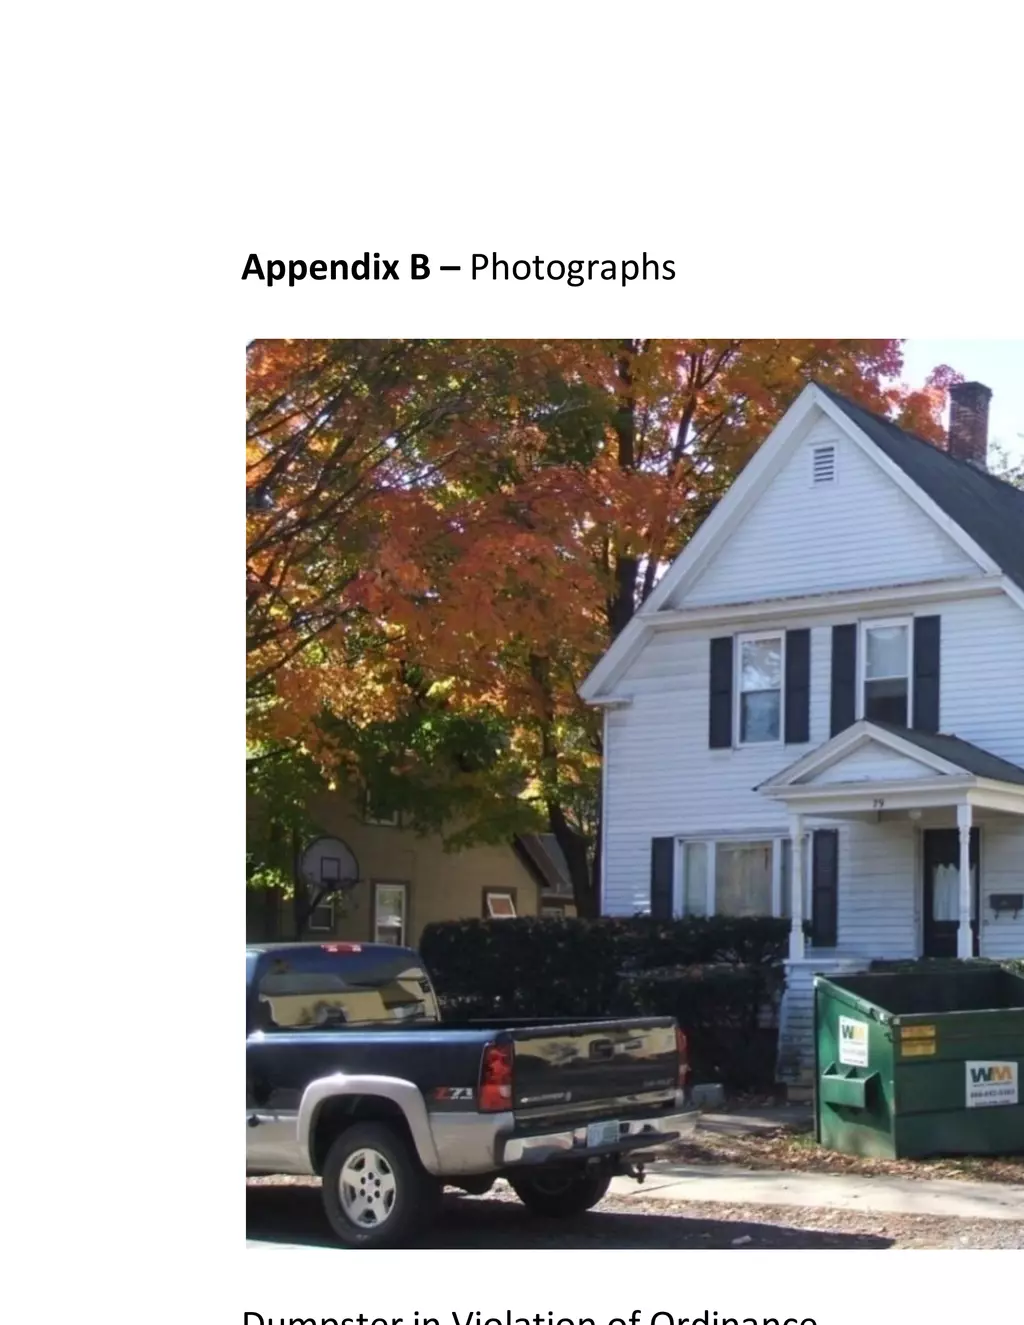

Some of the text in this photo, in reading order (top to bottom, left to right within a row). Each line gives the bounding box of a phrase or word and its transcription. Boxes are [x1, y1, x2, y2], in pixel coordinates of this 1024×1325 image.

[240, 251, 400, 288] Appendix
[410, 253, 431, 281] B
[471, 251, 676, 288] Photographs
[970, 1066, 1013, 1083] WM
[433, 1086, 473, 1100] Z71
